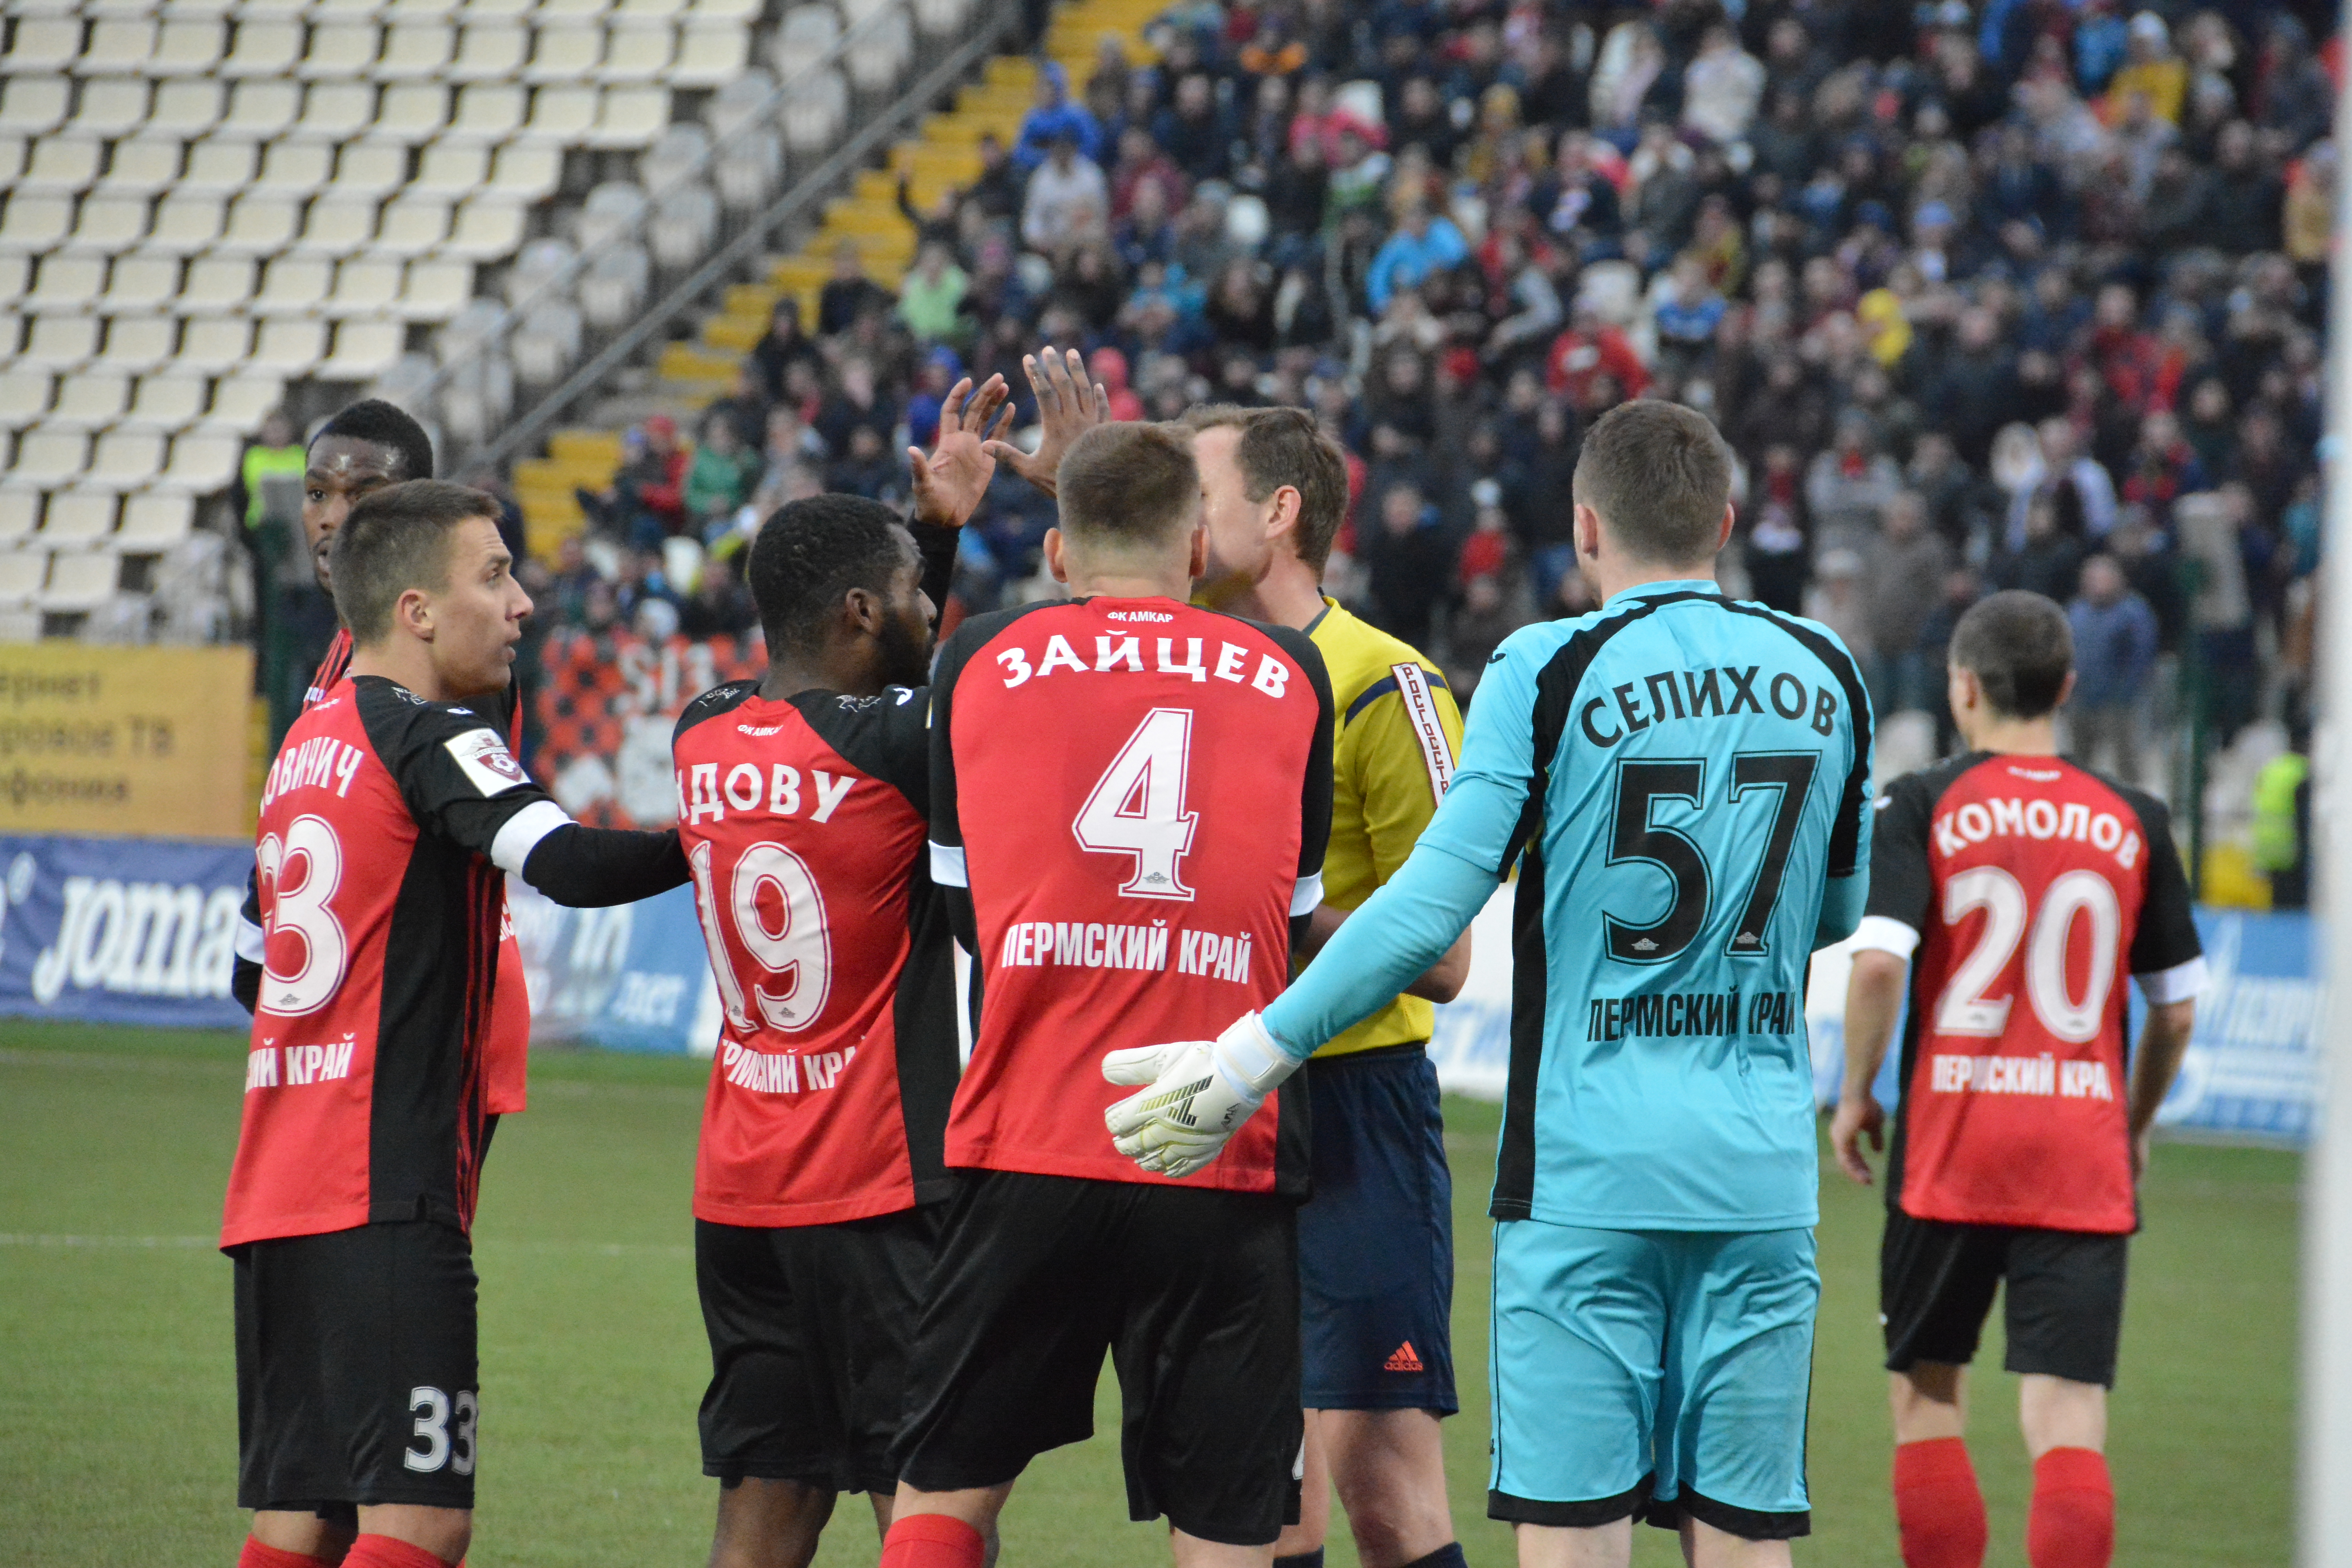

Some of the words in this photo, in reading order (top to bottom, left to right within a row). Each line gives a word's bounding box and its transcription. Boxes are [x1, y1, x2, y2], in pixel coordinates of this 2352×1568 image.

[1107, 612, 1127, 622] ФК
[1128, 611, 1173, 622] АМКАР
[996, 630, 1289, 698] ЗАЙЦЕВ
[737, 725, 755, 735] ФК
[1581, 665, 1837, 748] СЕЛИХОВ
[260, 737, 364, 818] ОВИЧИЧ
[1072, 707, 1200, 902] 4
[1602, 750, 1822, 966] 57
[1934, 798, 2141, 870] КОМОЛОВ
[690, 840, 831, 1033] 19
[1002, 919, 1168, 971] ПЕРМСКИЙ
[1178, 930, 1252, 984] КРАЙ
[1933, 865, 2122, 1044] 20
[1587, 984, 1740, 1042] ПЕРМСКИЙ
[285, 1033, 355, 1085] КРАЙ
[1384, 1360, 1424, 1371] adidas
[404, 1387, 478, 1476] 33
